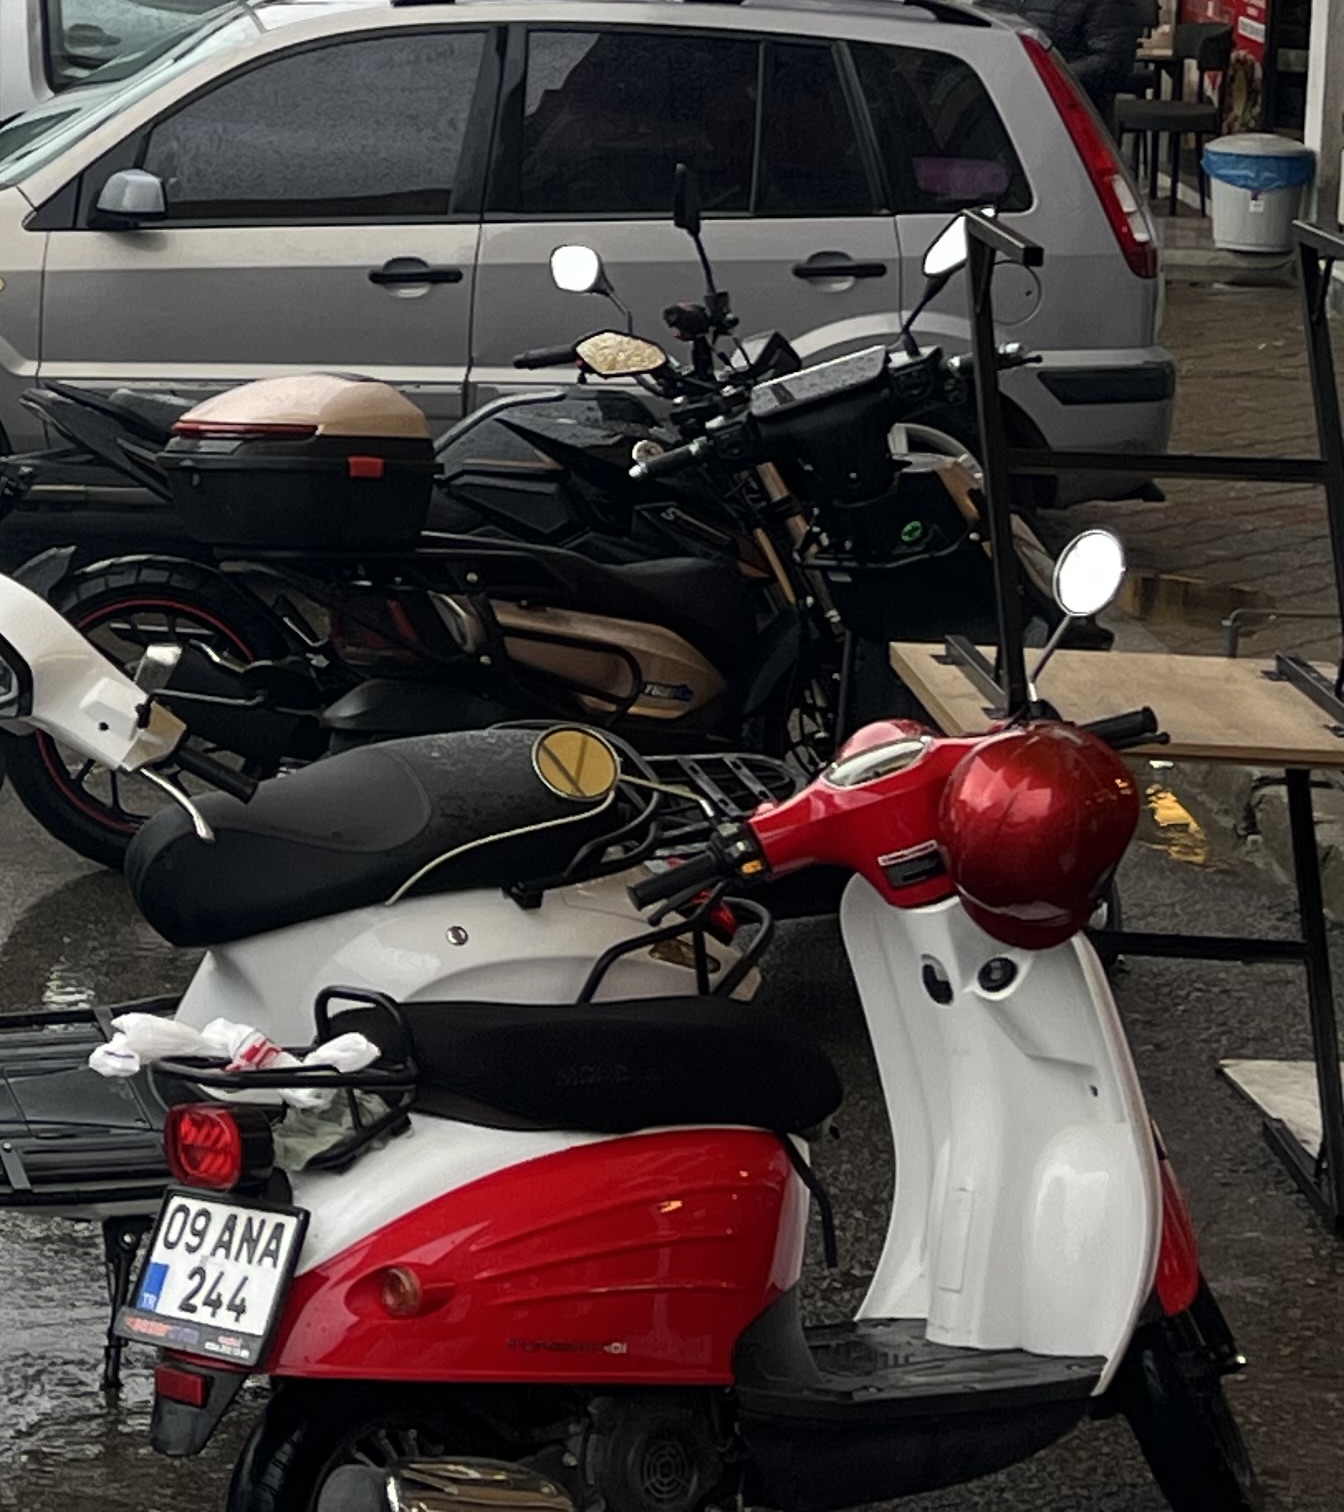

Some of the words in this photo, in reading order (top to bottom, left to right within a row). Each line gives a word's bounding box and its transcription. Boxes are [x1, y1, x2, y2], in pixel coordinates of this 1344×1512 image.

[163, 1203, 211, 1254] 09
[210, 1213, 285, 1269] ANA
[178, 1266, 249, 1323] 244
